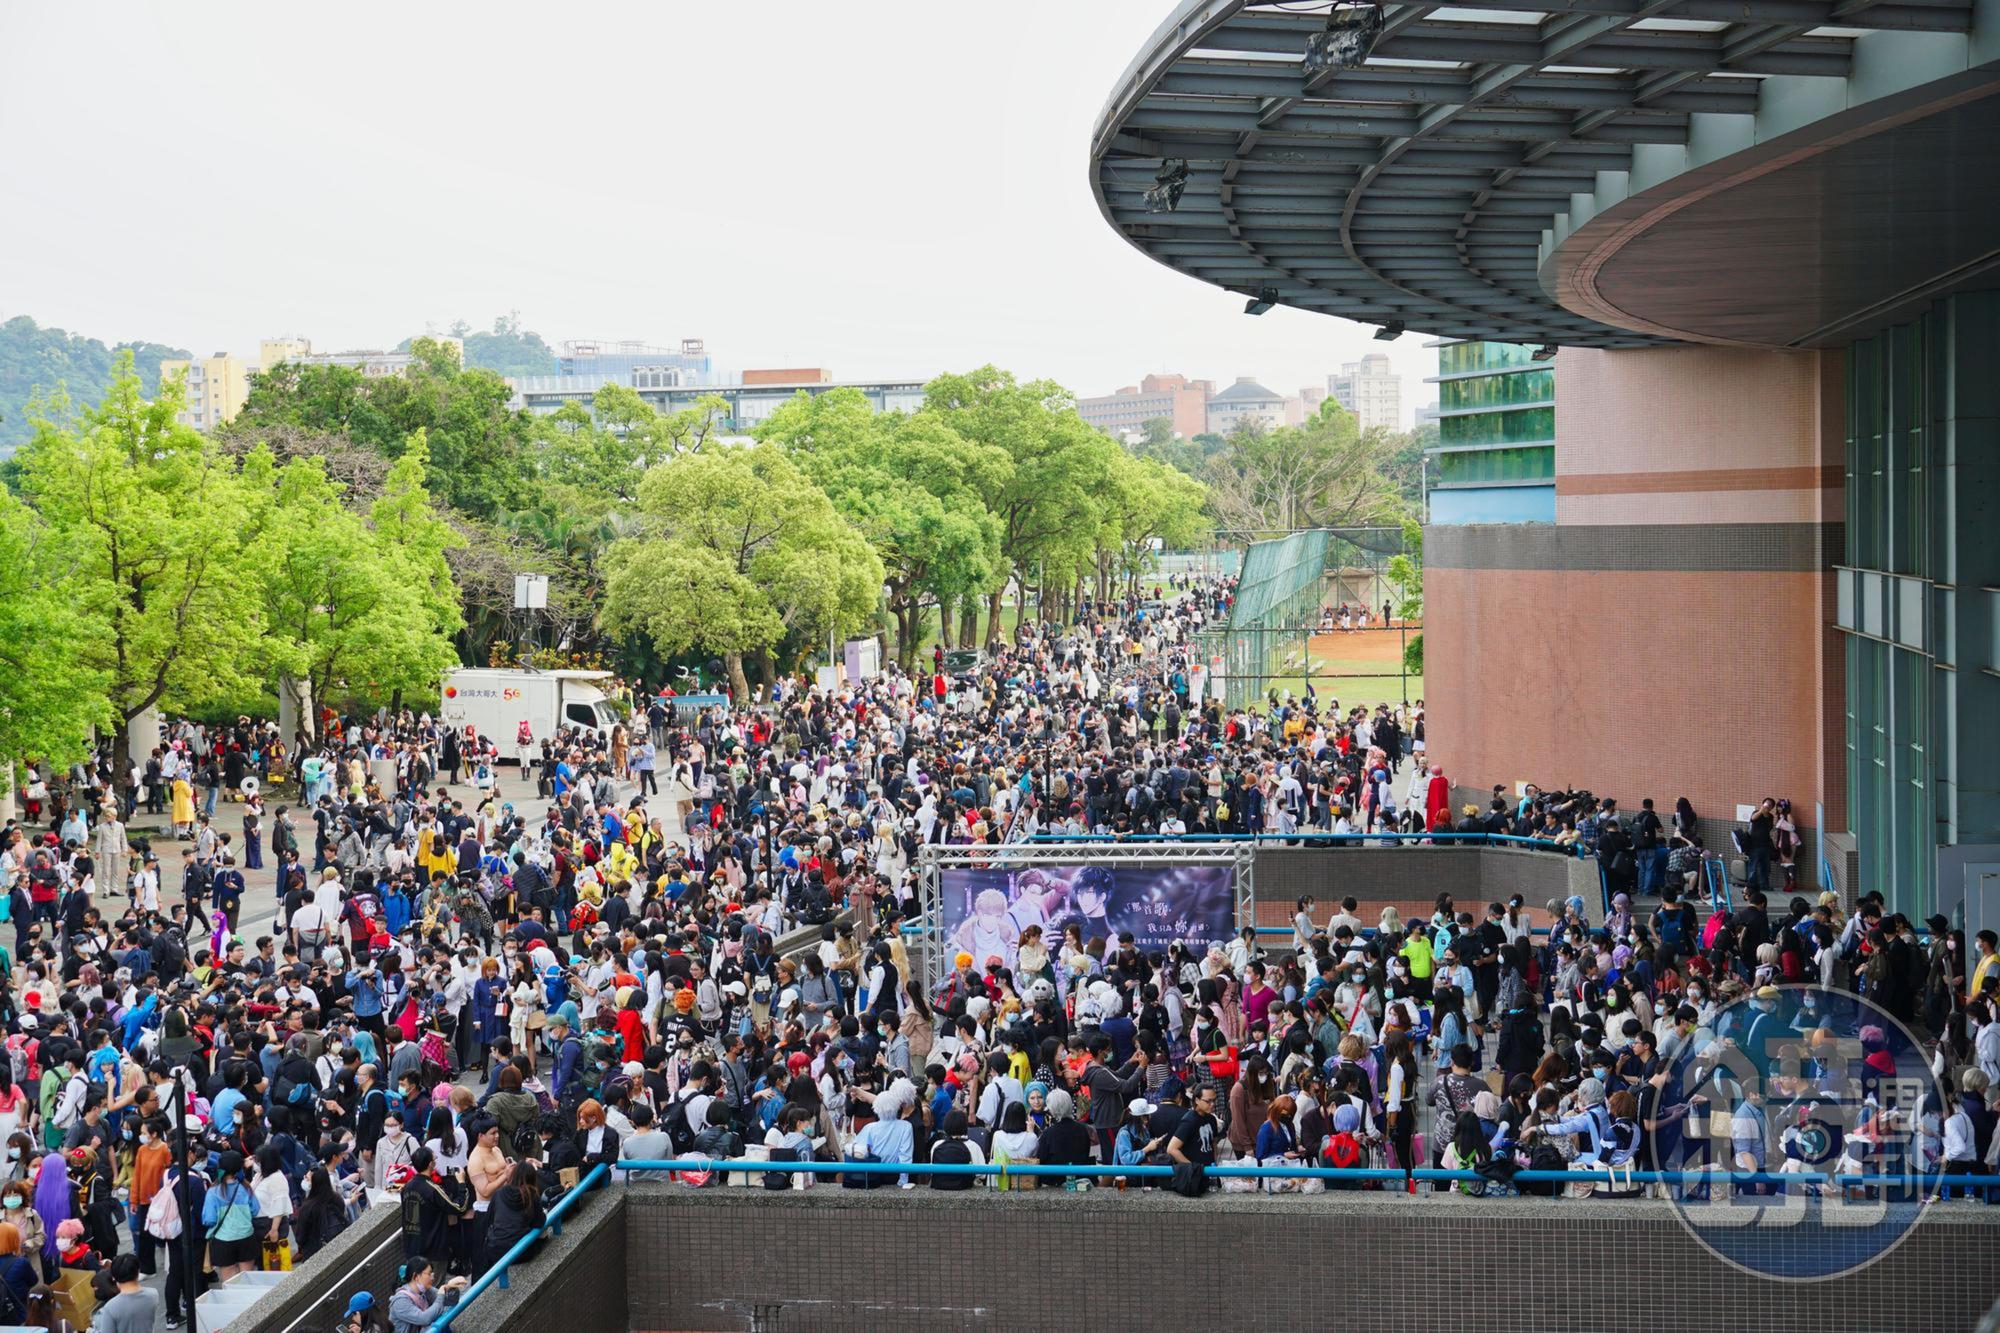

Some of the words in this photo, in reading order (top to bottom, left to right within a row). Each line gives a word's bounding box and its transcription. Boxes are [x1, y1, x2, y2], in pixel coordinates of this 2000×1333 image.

[460, 688, 497, 698] 台灣大哥大
[503, 688, 520, 701] 5G
